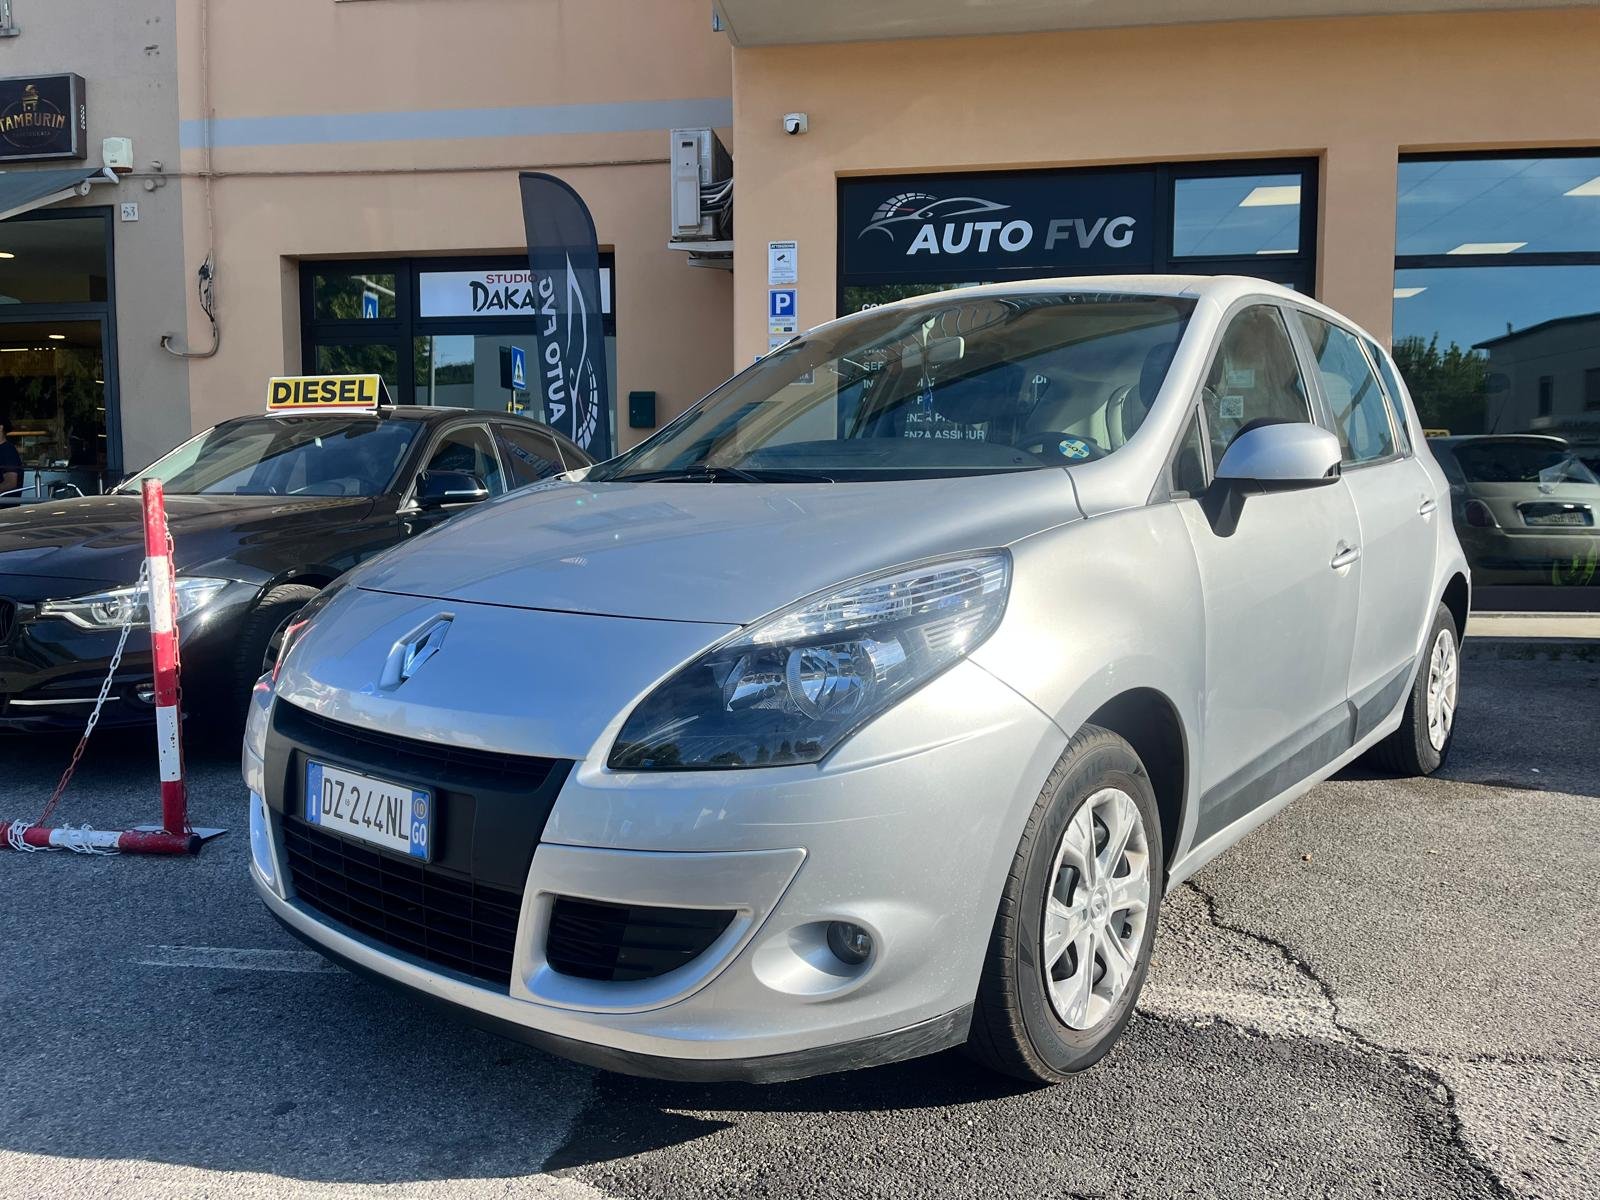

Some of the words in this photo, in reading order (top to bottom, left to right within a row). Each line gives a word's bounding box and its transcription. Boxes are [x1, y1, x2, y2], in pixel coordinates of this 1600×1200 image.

[906, 219, 1033, 255] AUTO
[1044, 215, 1136, 249] FVG
[486, 273, 538, 284] STUDIO
[469, 280, 538, 312] DAKA
[272, 379, 373, 404] DIESEL
[412, 821, 427, 847] GO
